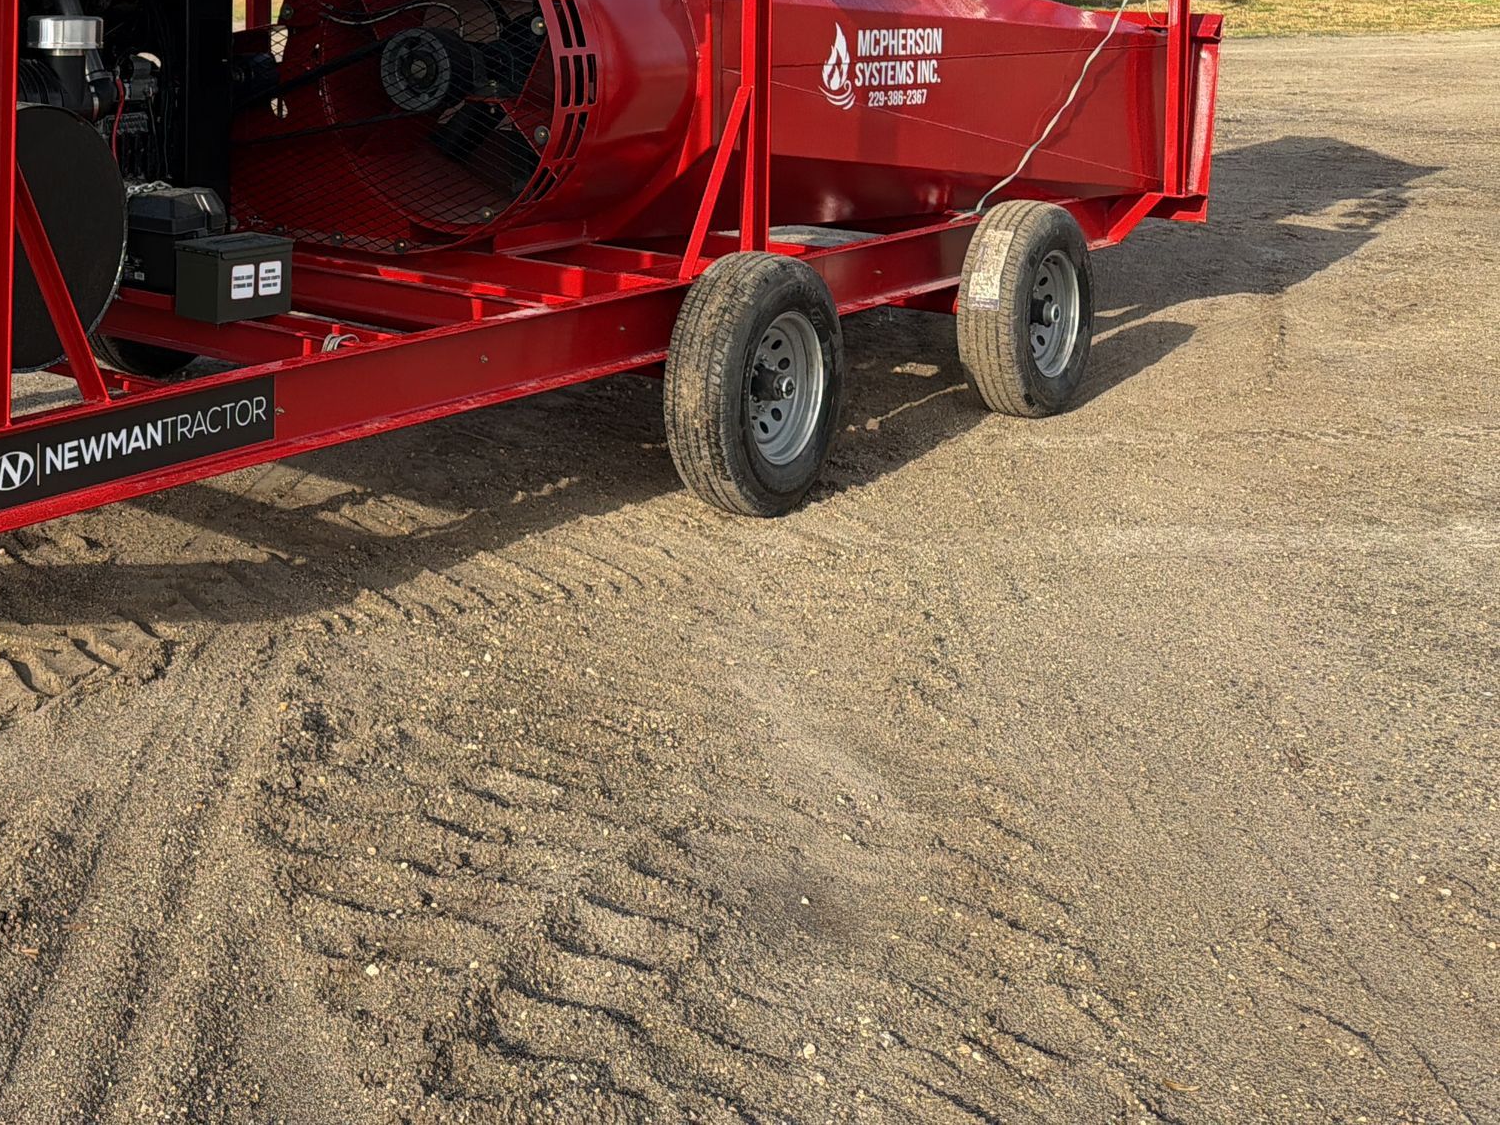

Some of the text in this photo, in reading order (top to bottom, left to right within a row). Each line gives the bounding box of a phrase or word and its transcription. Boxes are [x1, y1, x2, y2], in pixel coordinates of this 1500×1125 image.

[857, 27, 943, 57] MCPHERSON
[854, 59, 941, 87] SYSTEMS INC.
[867, 88, 927, 107] 229-386-2367
